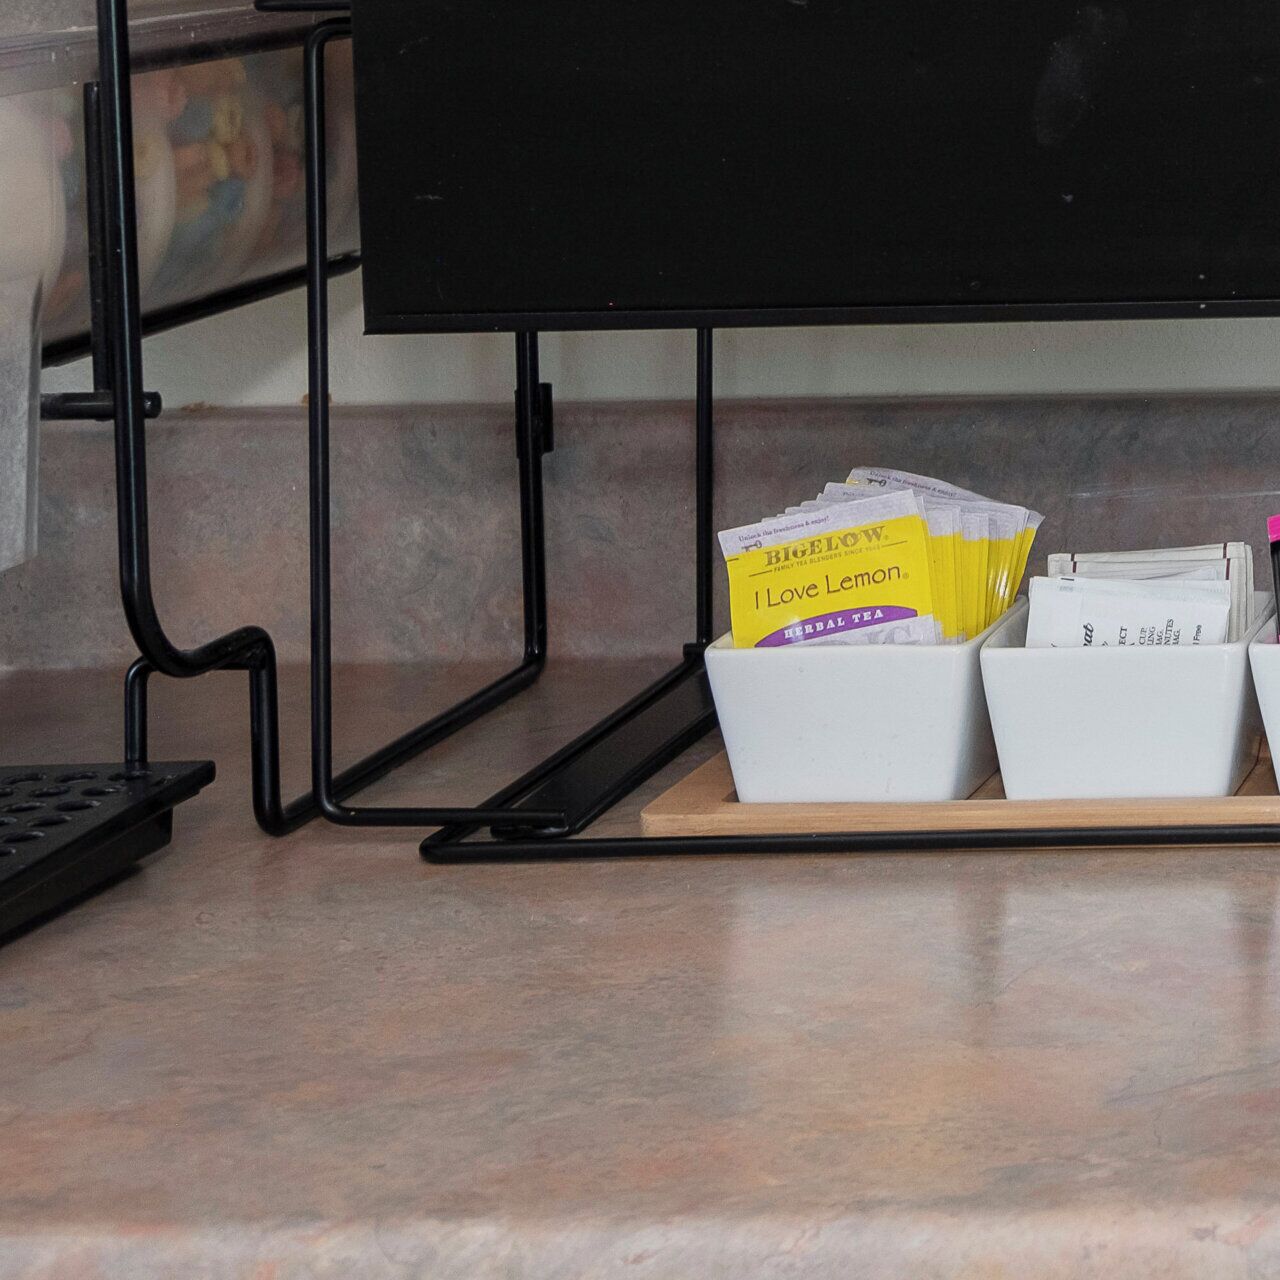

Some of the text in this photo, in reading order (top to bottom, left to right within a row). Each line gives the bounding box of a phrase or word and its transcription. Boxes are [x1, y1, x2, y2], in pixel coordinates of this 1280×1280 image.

[764, 525, 886, 567] BIGELOW
[755, 565, 901, 610] I Love Lemon
[784, 617, 846, 639] HERBAL
[852, 609, 884, 623] TEA
[1164, 618, 1174, 645] NUTES
